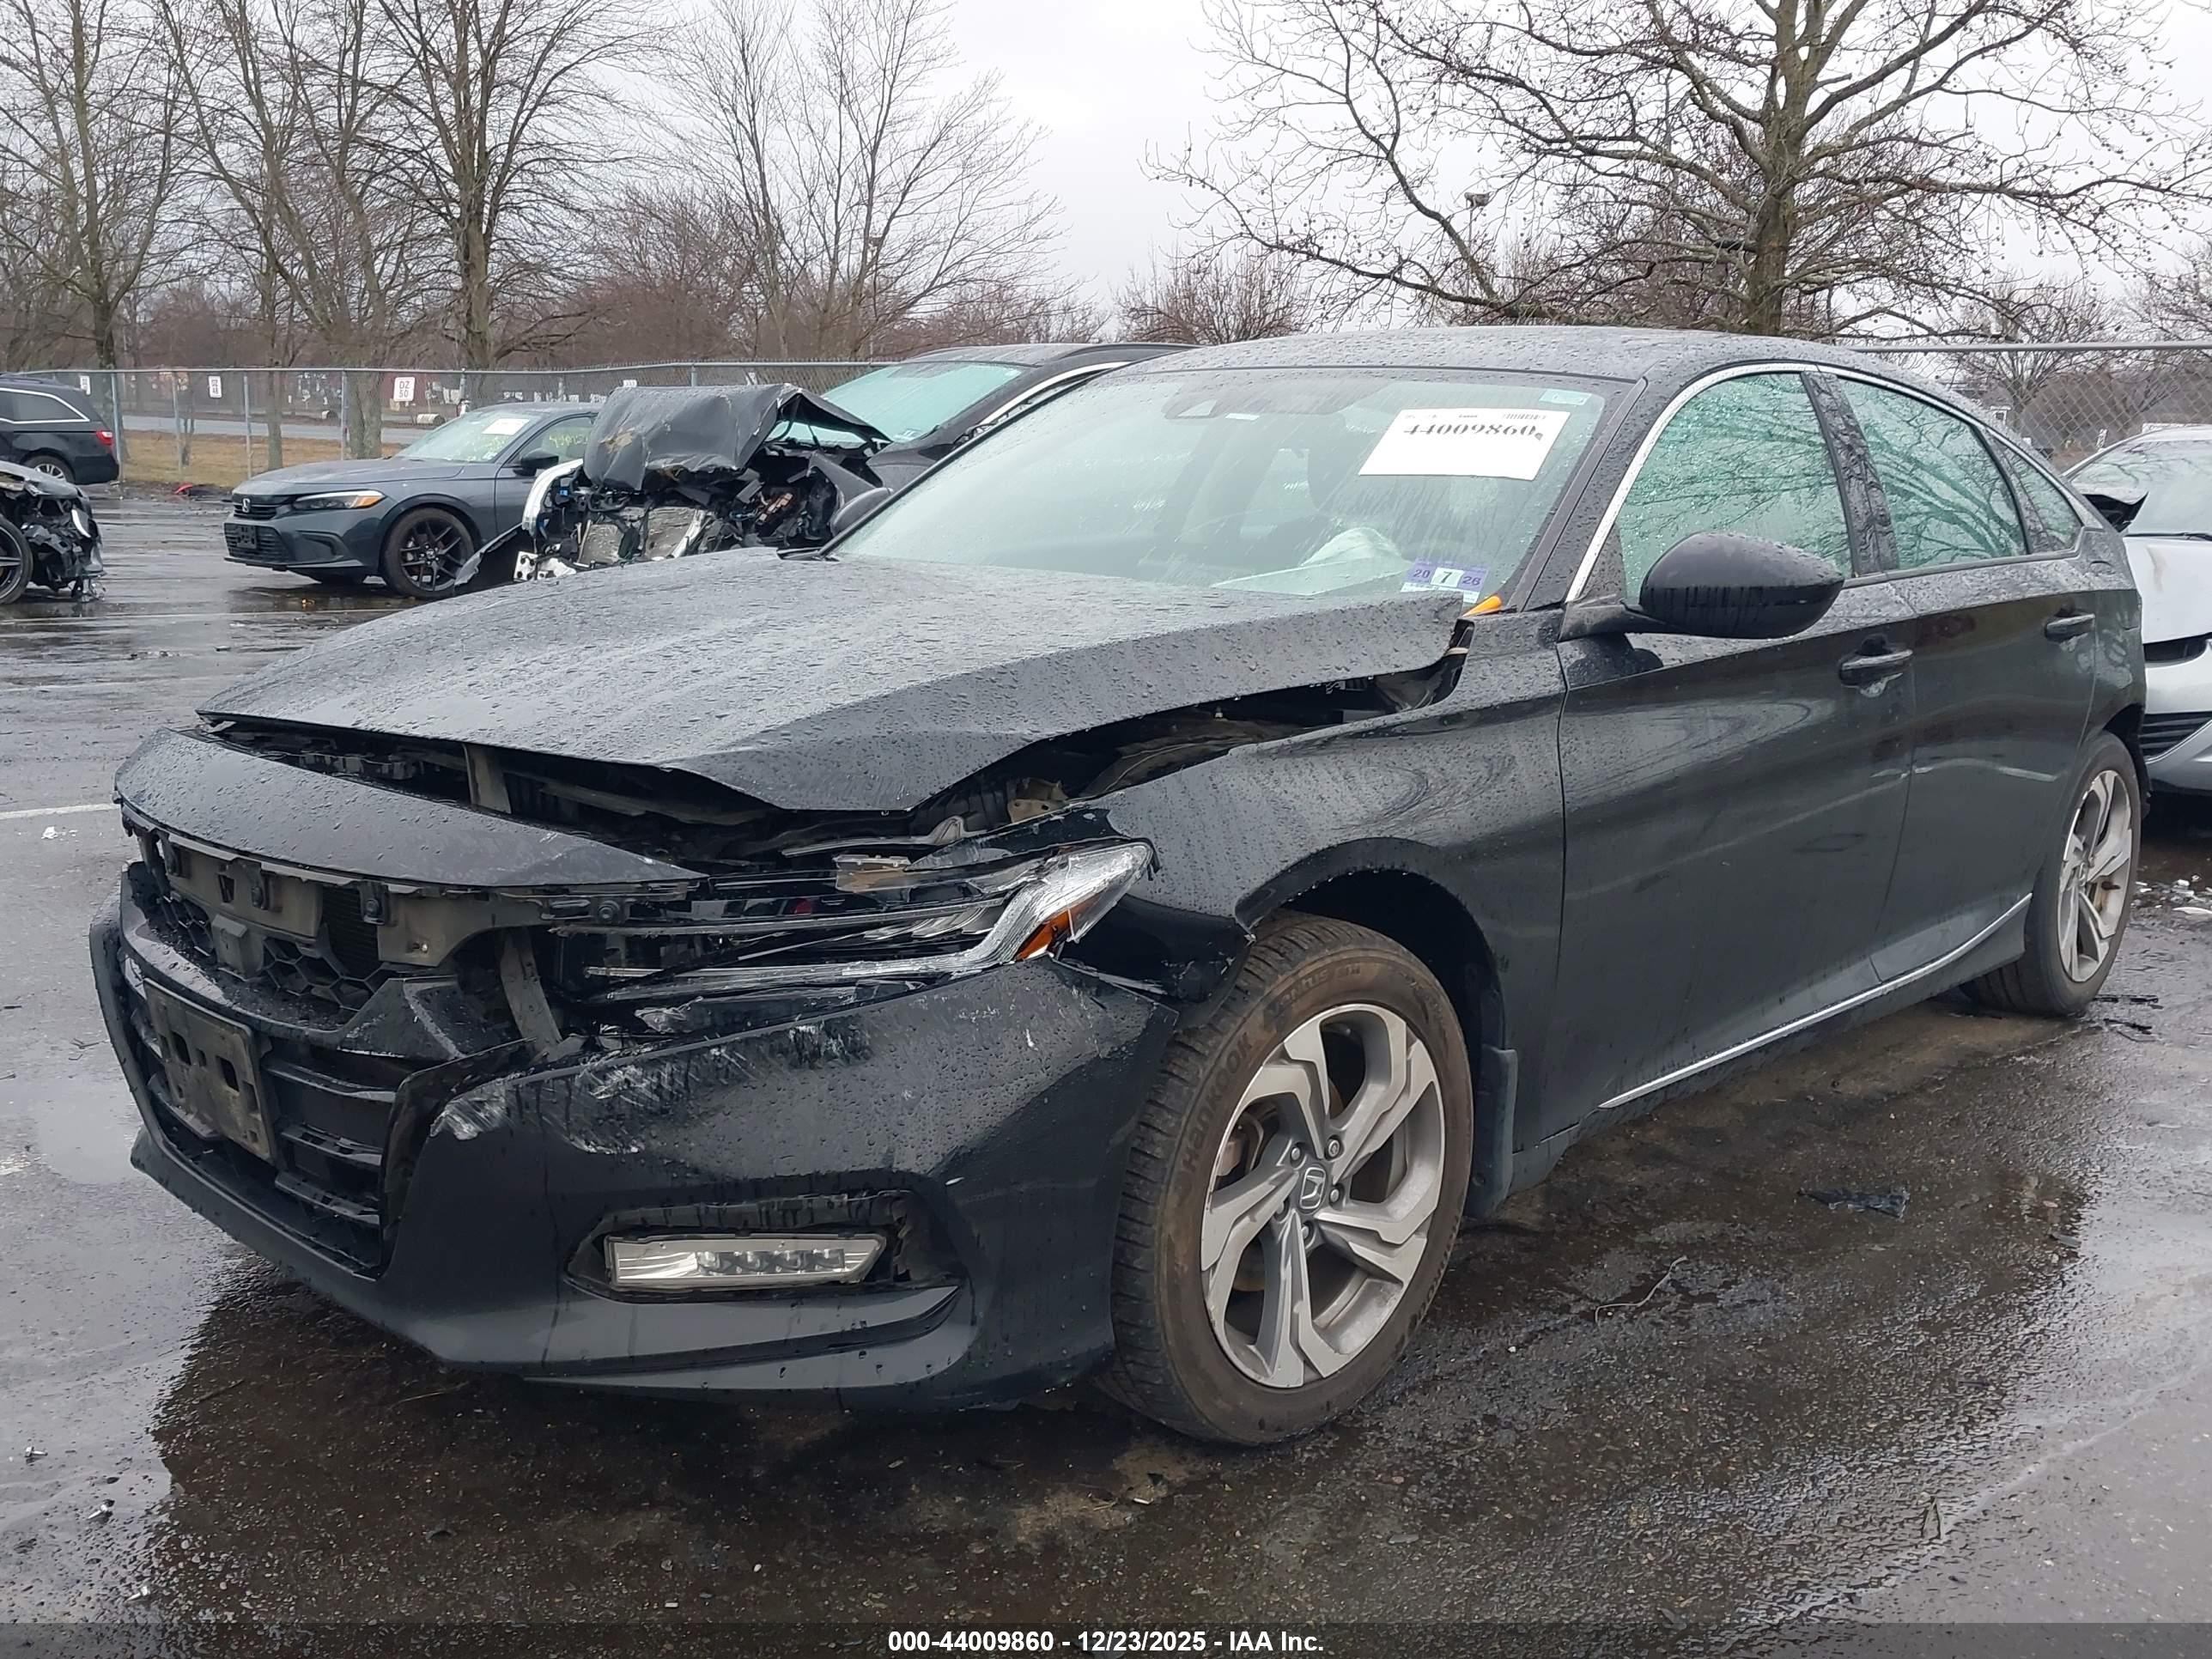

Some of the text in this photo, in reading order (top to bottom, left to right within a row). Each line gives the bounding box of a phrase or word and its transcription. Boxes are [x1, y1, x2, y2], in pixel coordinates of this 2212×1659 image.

[1403, 424, 1537, 435] 44009860
[1413, 569, 1481, 586] 20 7 26
